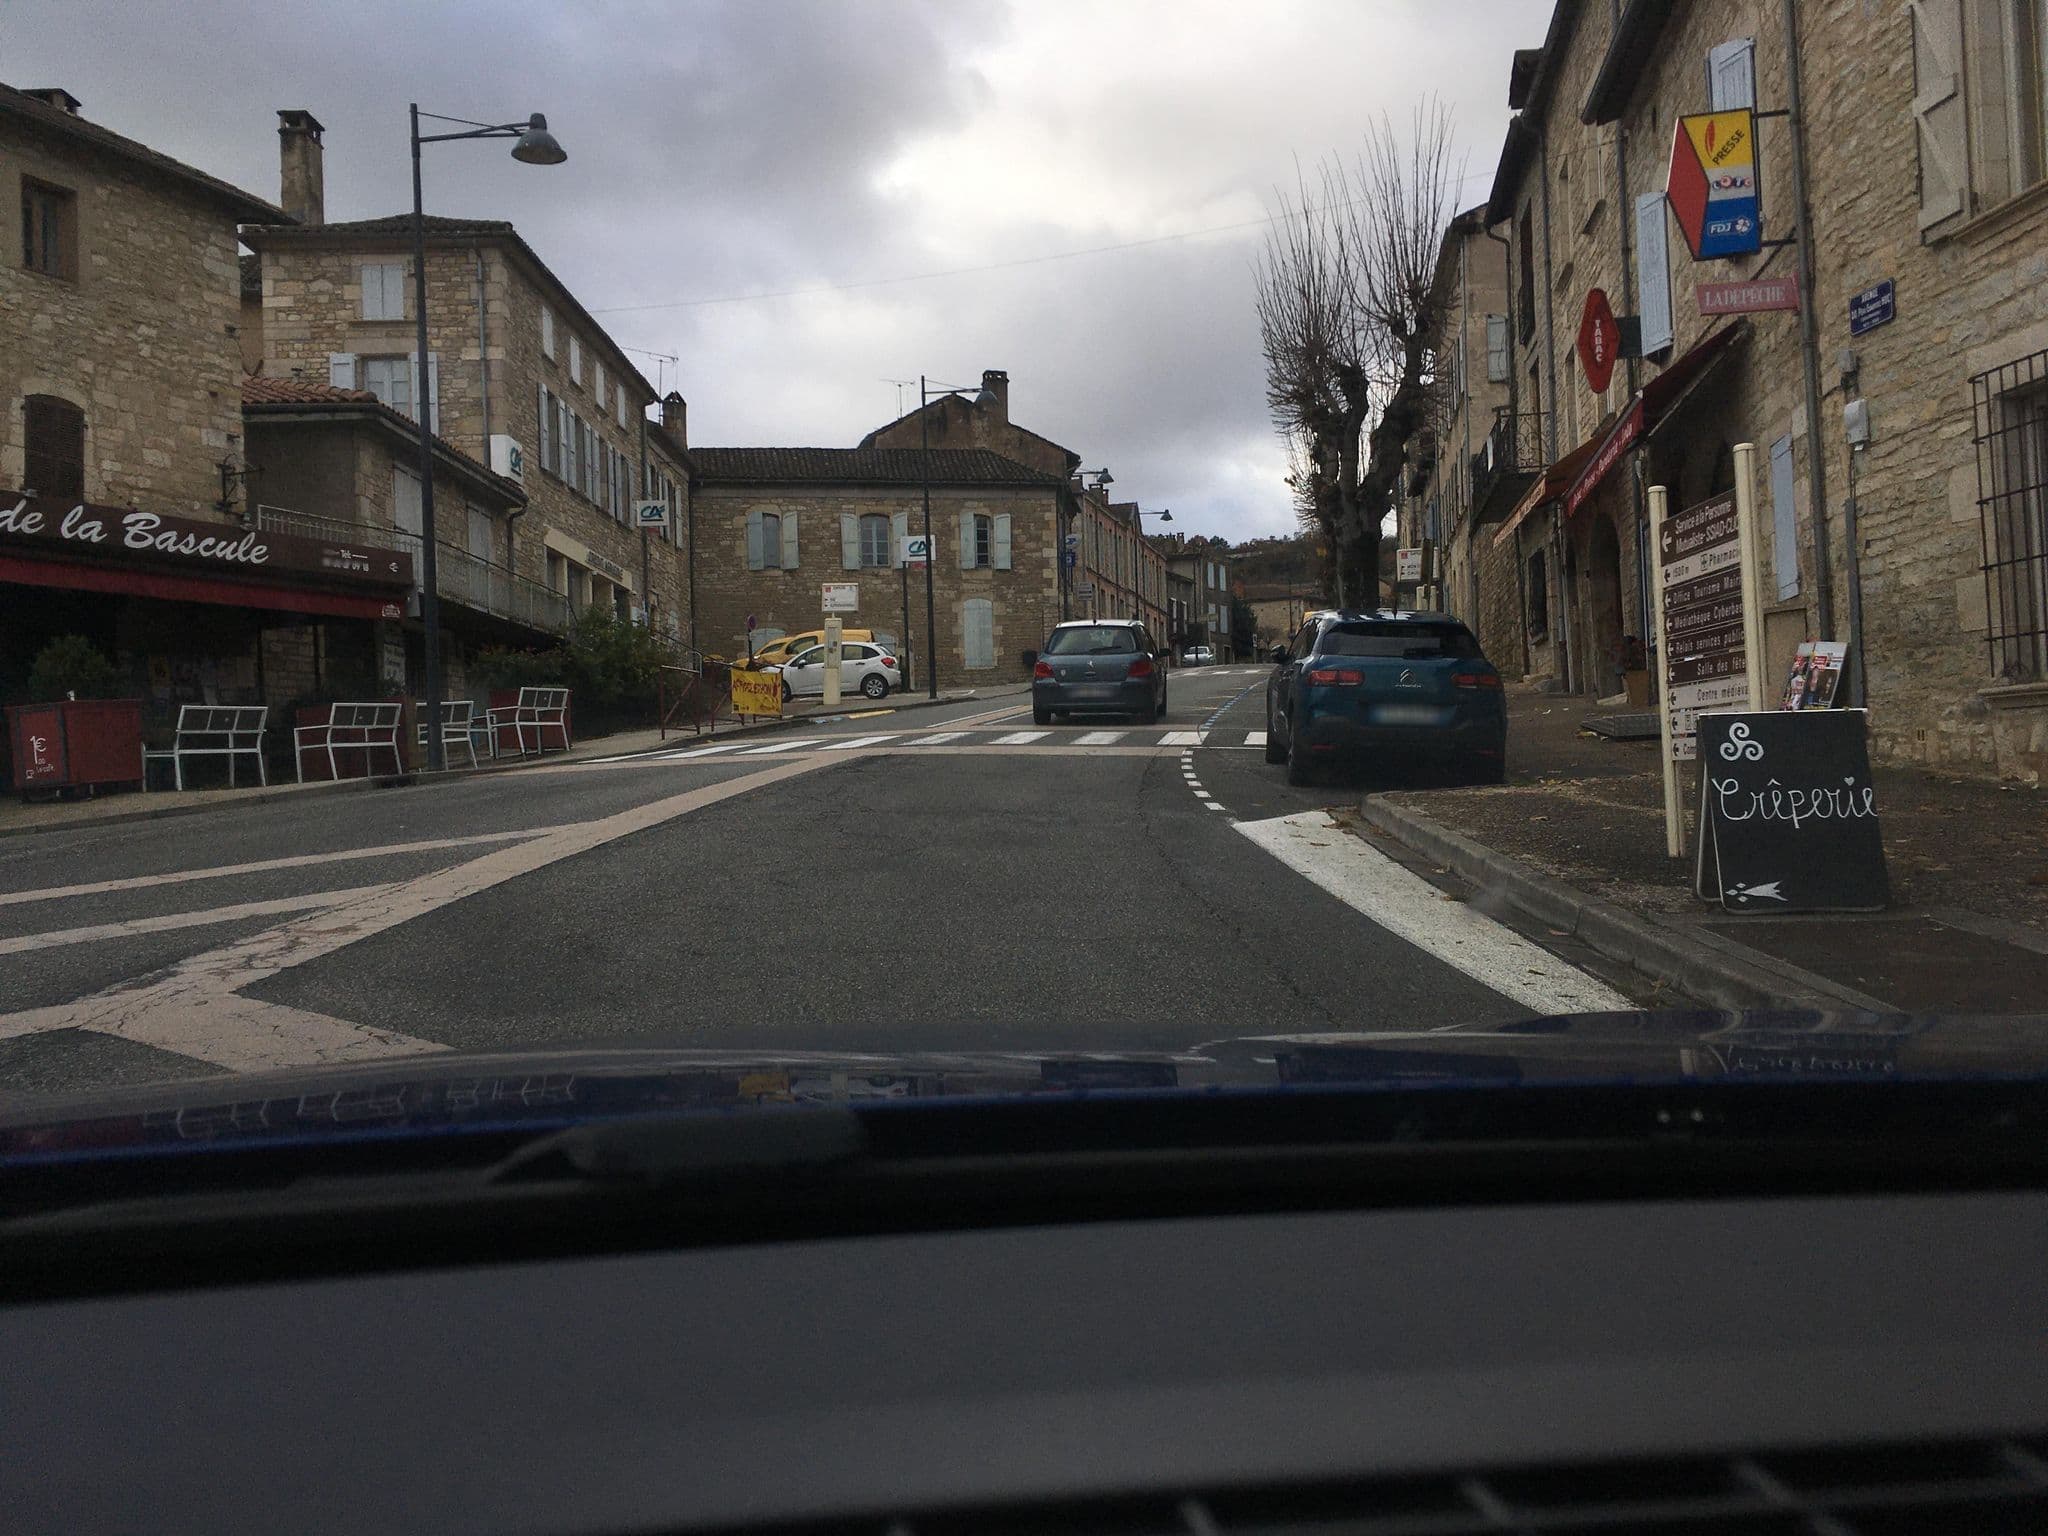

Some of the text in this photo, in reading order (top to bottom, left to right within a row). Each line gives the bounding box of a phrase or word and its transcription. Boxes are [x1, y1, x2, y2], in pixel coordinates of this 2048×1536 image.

[1711, 128, 1746, 166] PRESSE
[1710, 222, 1732, 235] FDJ
[1594, 319, 1602, 362] TABAC
[0, 499, 269, 565] de la Bascule
[1693, 582, 1721, 599] Tourisme
[1696, 634, 1721, 650] services
[1697, 660, 1713, 676] Salle
[1717, 657, 1728, 673] des
[1697, 687, 1718, 702] Centre
[1711, 777, 1878, 829] Crêperie
